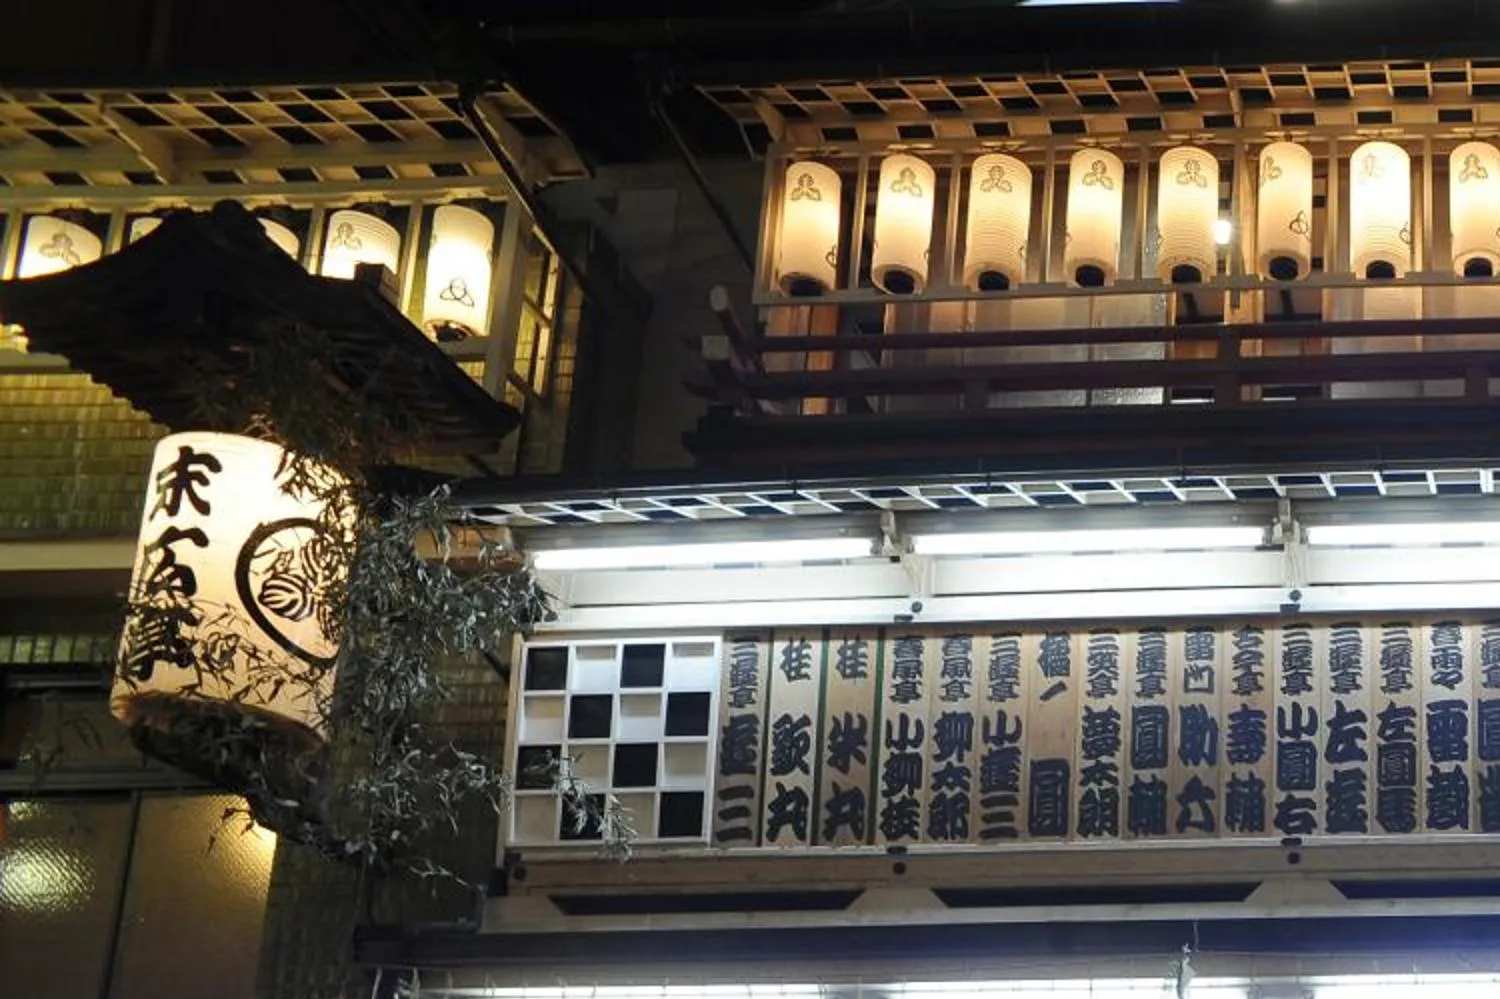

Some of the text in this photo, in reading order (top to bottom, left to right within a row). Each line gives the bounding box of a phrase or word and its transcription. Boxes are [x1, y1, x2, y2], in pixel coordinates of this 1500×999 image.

[767, 636, 814, 842] 桂歌丸
[823, 634, 868, 842] 桂米丸
